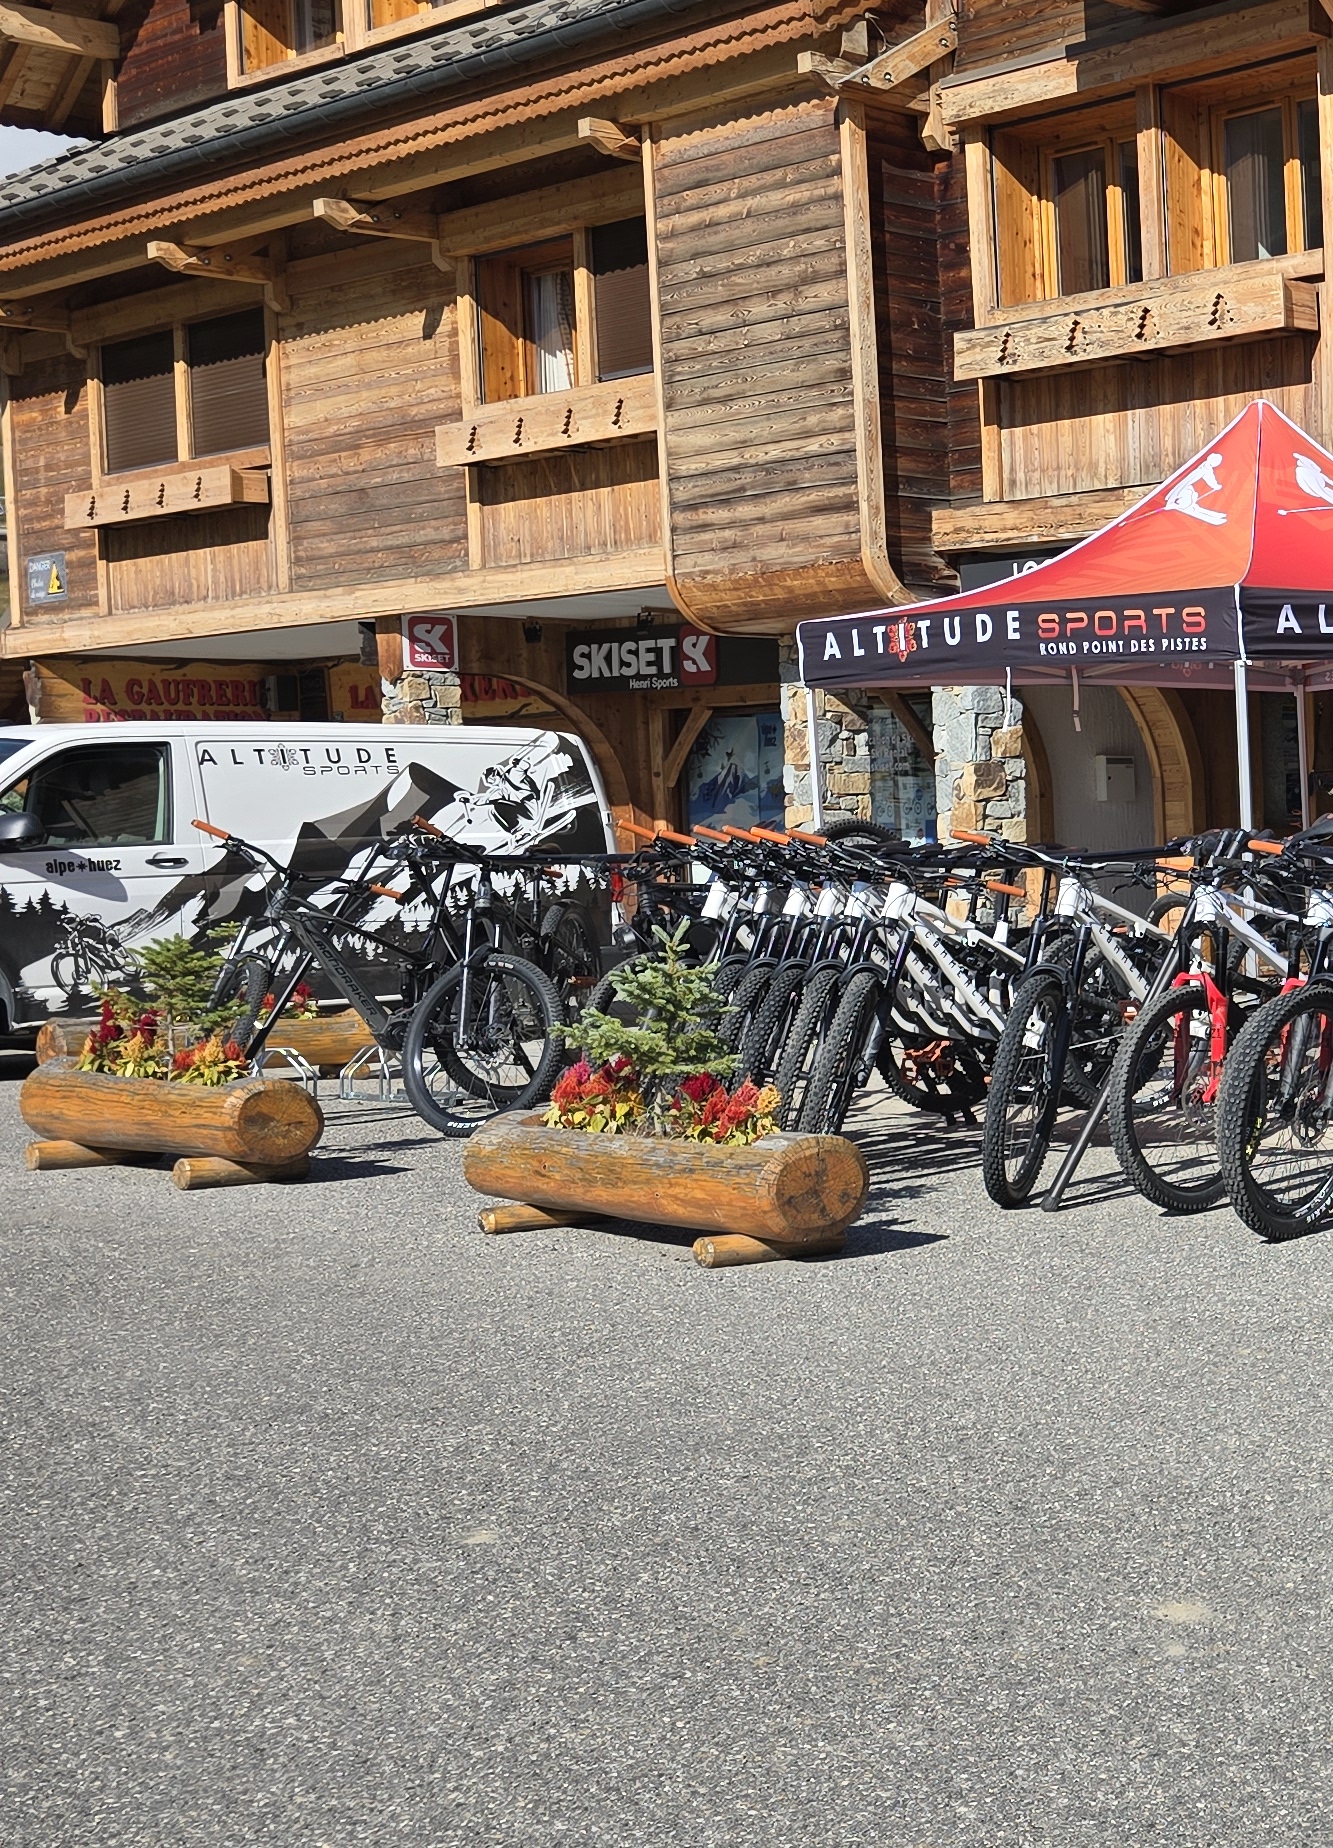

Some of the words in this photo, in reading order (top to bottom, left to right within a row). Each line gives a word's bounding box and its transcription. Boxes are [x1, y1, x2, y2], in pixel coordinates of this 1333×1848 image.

[821, 610, 1022, 661] ALTITUDE
[1036, 606, 1207, 640] SPORTS
[1039, 640, 1078, 656] ROND
[1082, 638, 1126, 655] POINT
[1129, 637, 1156, 653] DES
[1161, 636, 1208, 652] PISTES
[414, 653, 450, 663] SKISET
[572, 637, 677, 680] SKISET
[80, 678, 118, 705] LA
[123, 678, 262, 708] GAUFRERI
[629, 677, 651, 690] Henri
[651, 676, 679, 690] Sports
[199, 747, 398, 766] ALTITUDE
[302, 765, 400, 776] SPORTS
[1098, 925, 1151, 991] COMMENC
